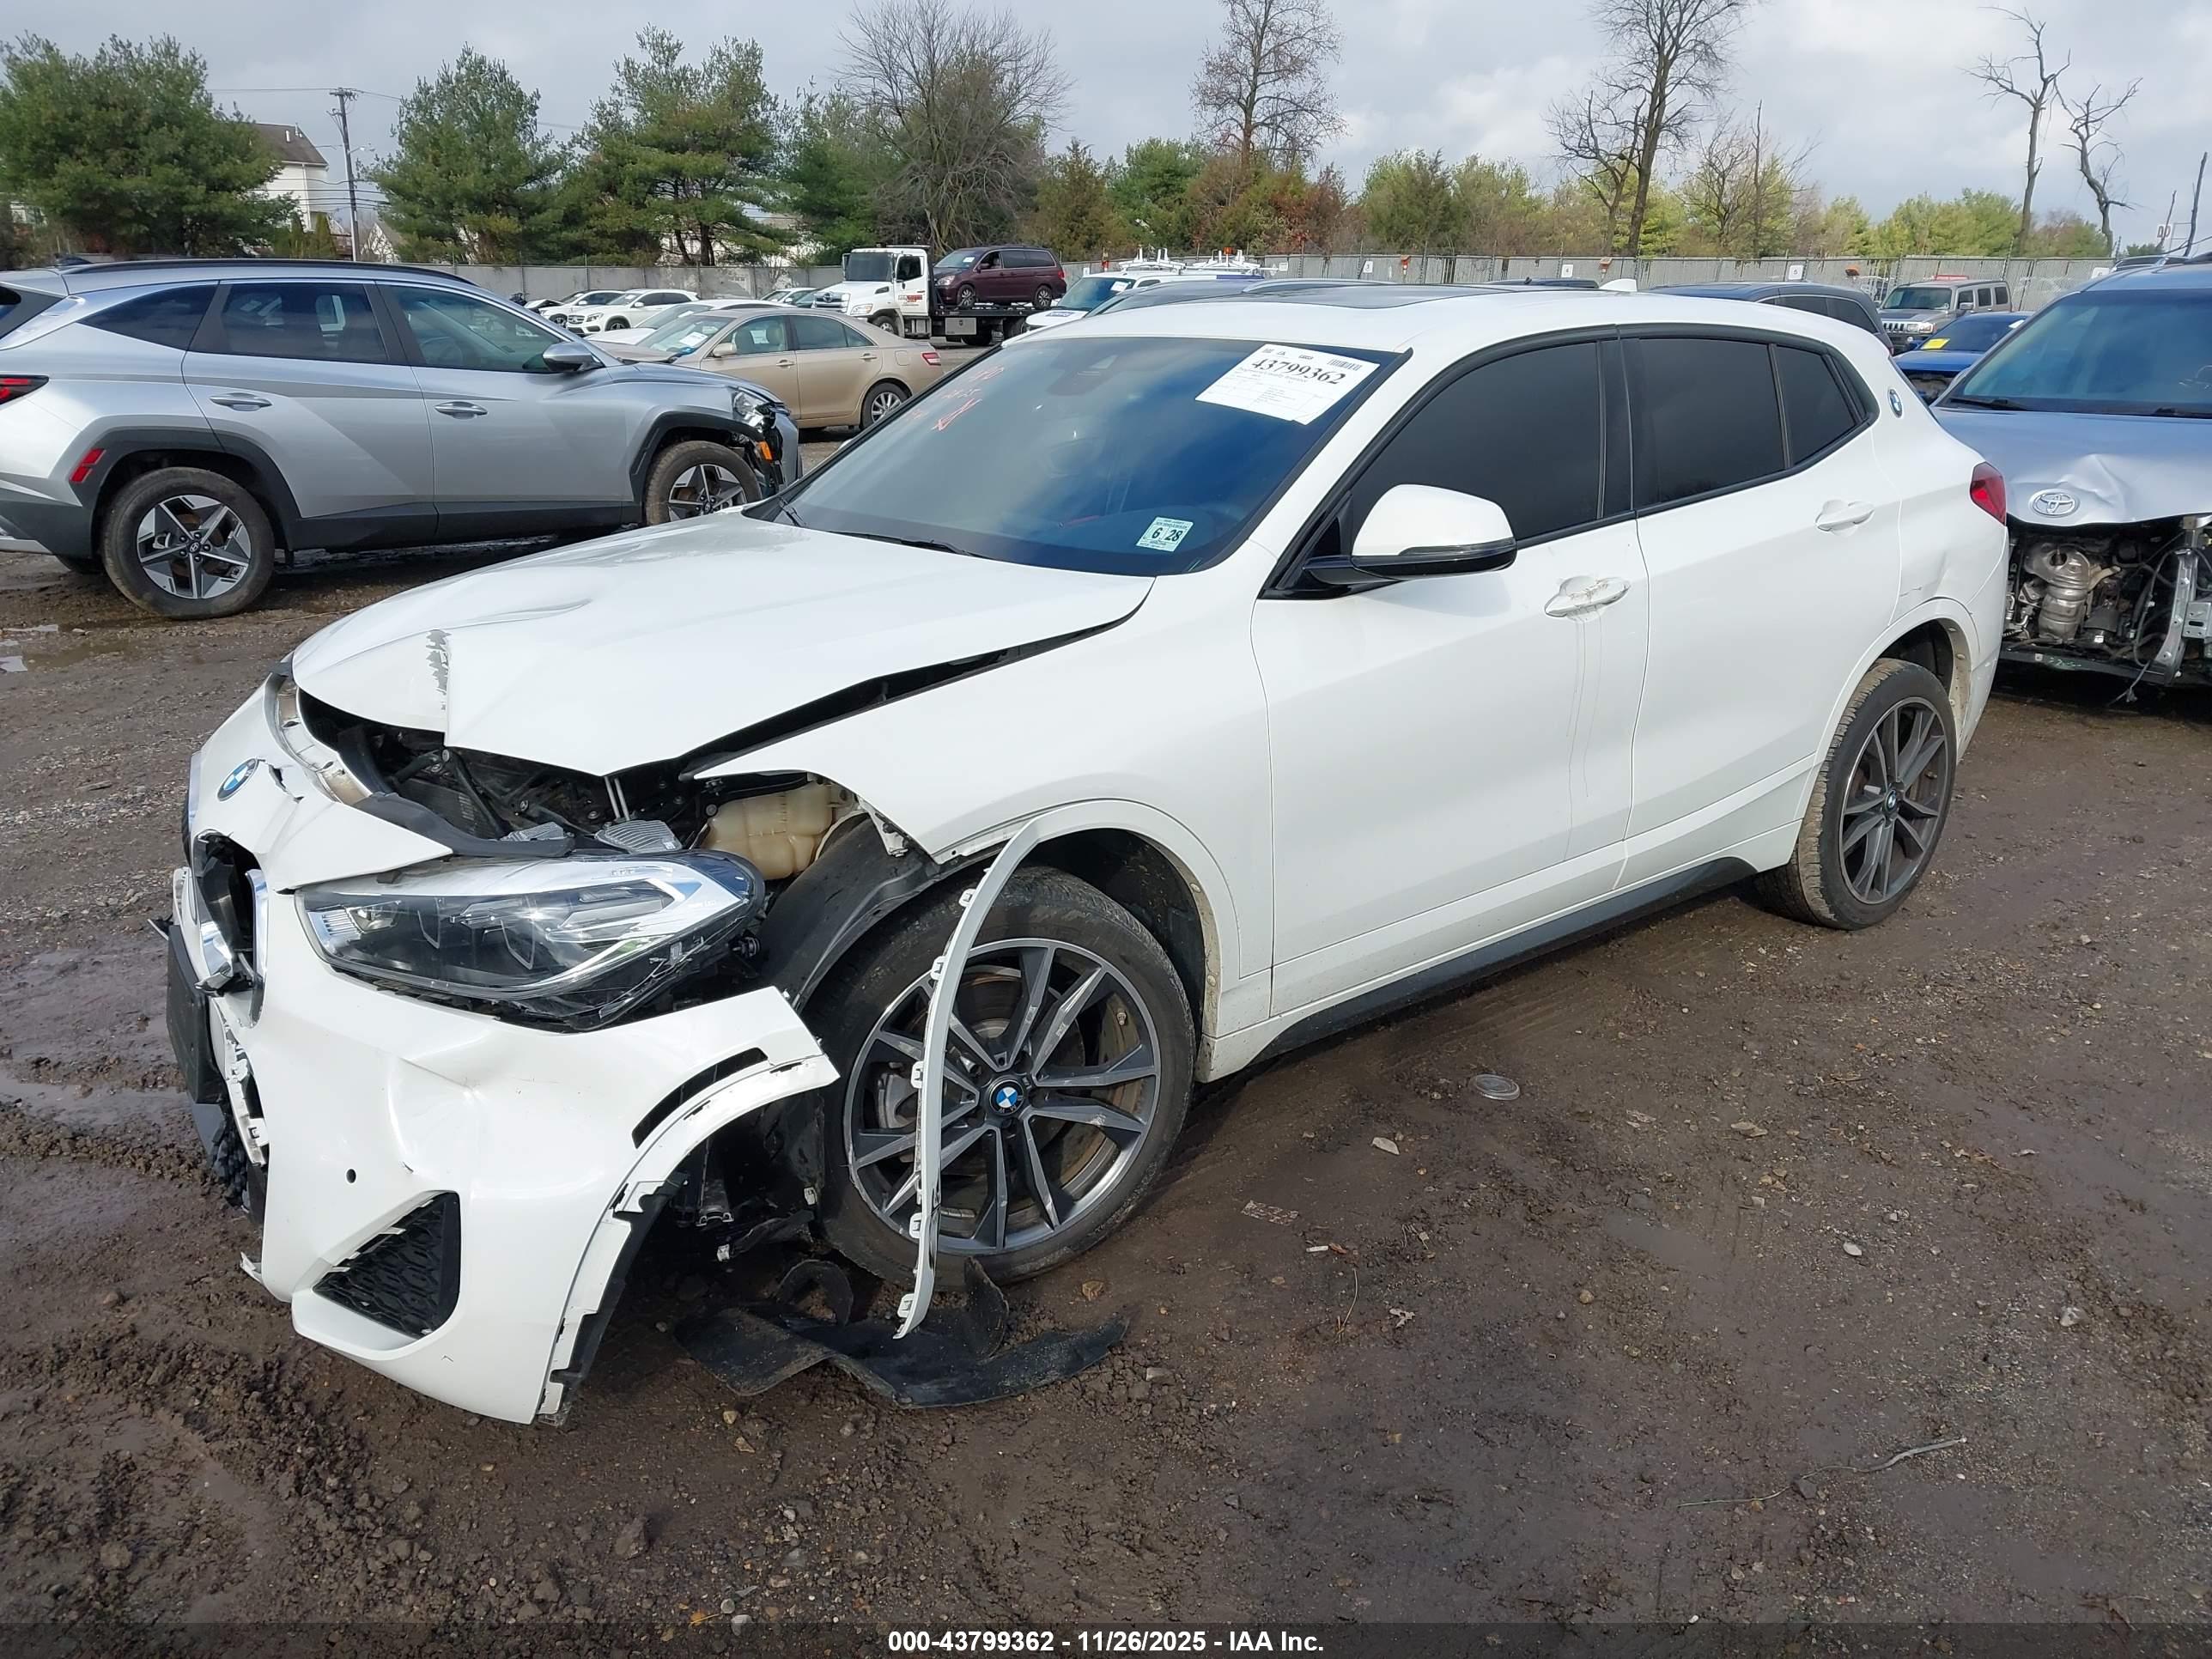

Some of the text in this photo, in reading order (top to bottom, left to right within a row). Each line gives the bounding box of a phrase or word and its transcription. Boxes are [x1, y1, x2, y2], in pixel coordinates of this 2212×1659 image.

[1252, 358, 1346, 385] 43799362
[1152, 527, 1183, 542] 6 28
